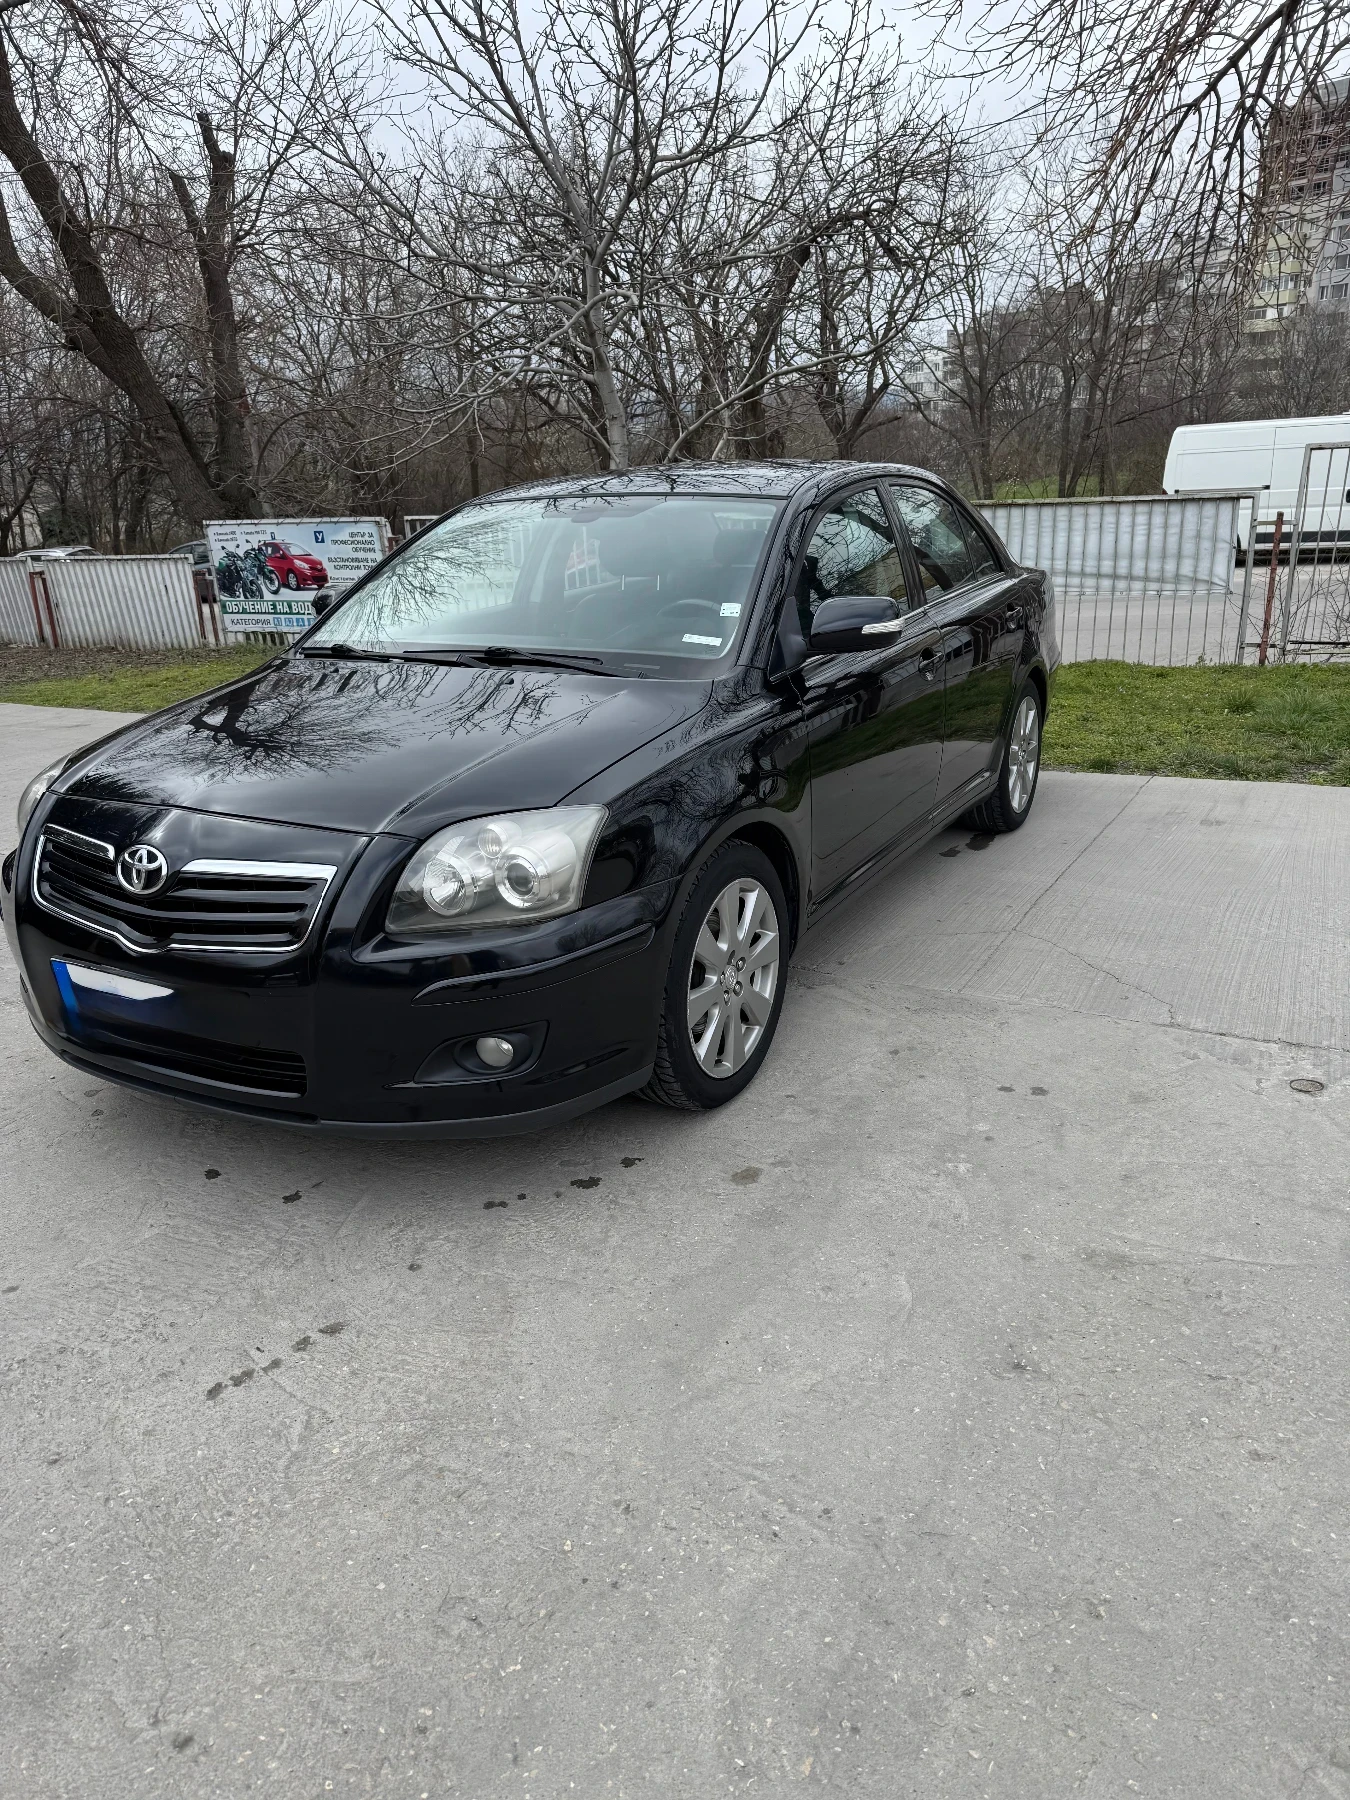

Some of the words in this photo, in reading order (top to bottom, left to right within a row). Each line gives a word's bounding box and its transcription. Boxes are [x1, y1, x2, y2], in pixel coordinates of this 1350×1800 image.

[348, 531, 367, 539] ЦЕНТЪР
[367, 531, 375, 539] ЗА
[351, 546, 377, 554] ОБУЧЕНИЕ
[225, 601, 275, 613] ОБУЧЕНИЕ
[275, 601, 290, 614] НА
[291, 601, 313, 616] ВОД
[230, 618, 272, 627] КАТЕГОРИЯ
